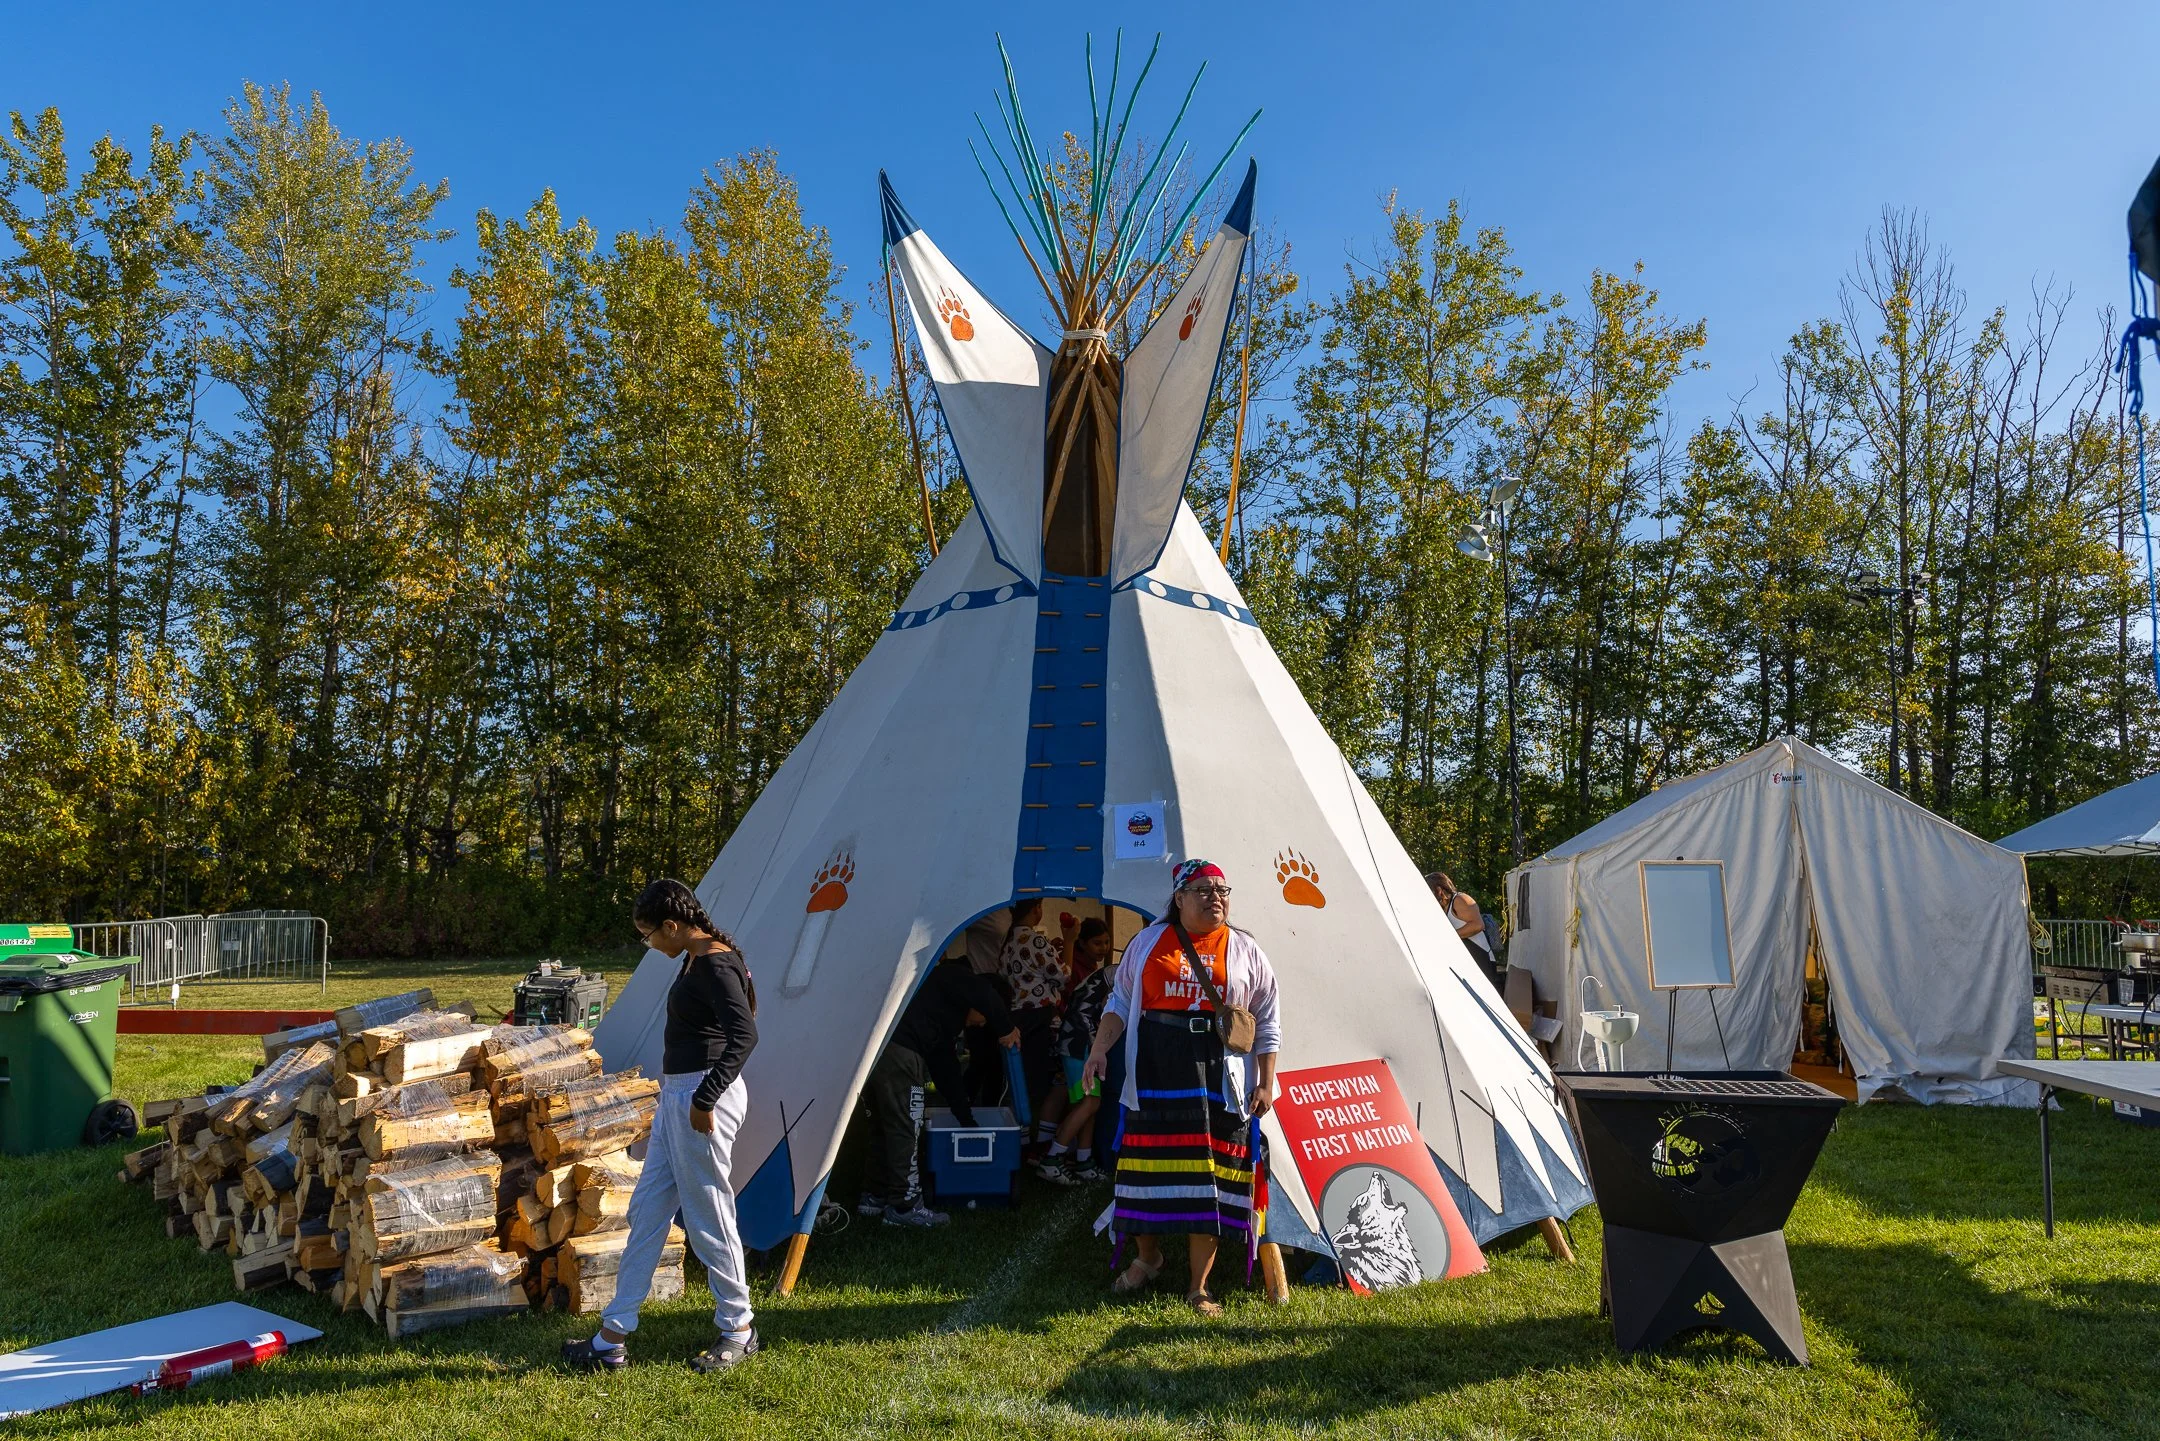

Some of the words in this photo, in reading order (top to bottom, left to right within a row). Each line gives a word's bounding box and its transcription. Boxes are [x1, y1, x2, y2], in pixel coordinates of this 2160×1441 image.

[1180, 953, 1217, 967] ERY
[1165, 980, 1224, 1001] MATTES
[1289, 1075, 1381, 1105] CHIPEWYAN
[1313, 1101, 1381, 1130] PRAIRIE
[1301, 1133, 1352, 1161] FIRST
[1352, 1124, 1413, 1152] NATION
